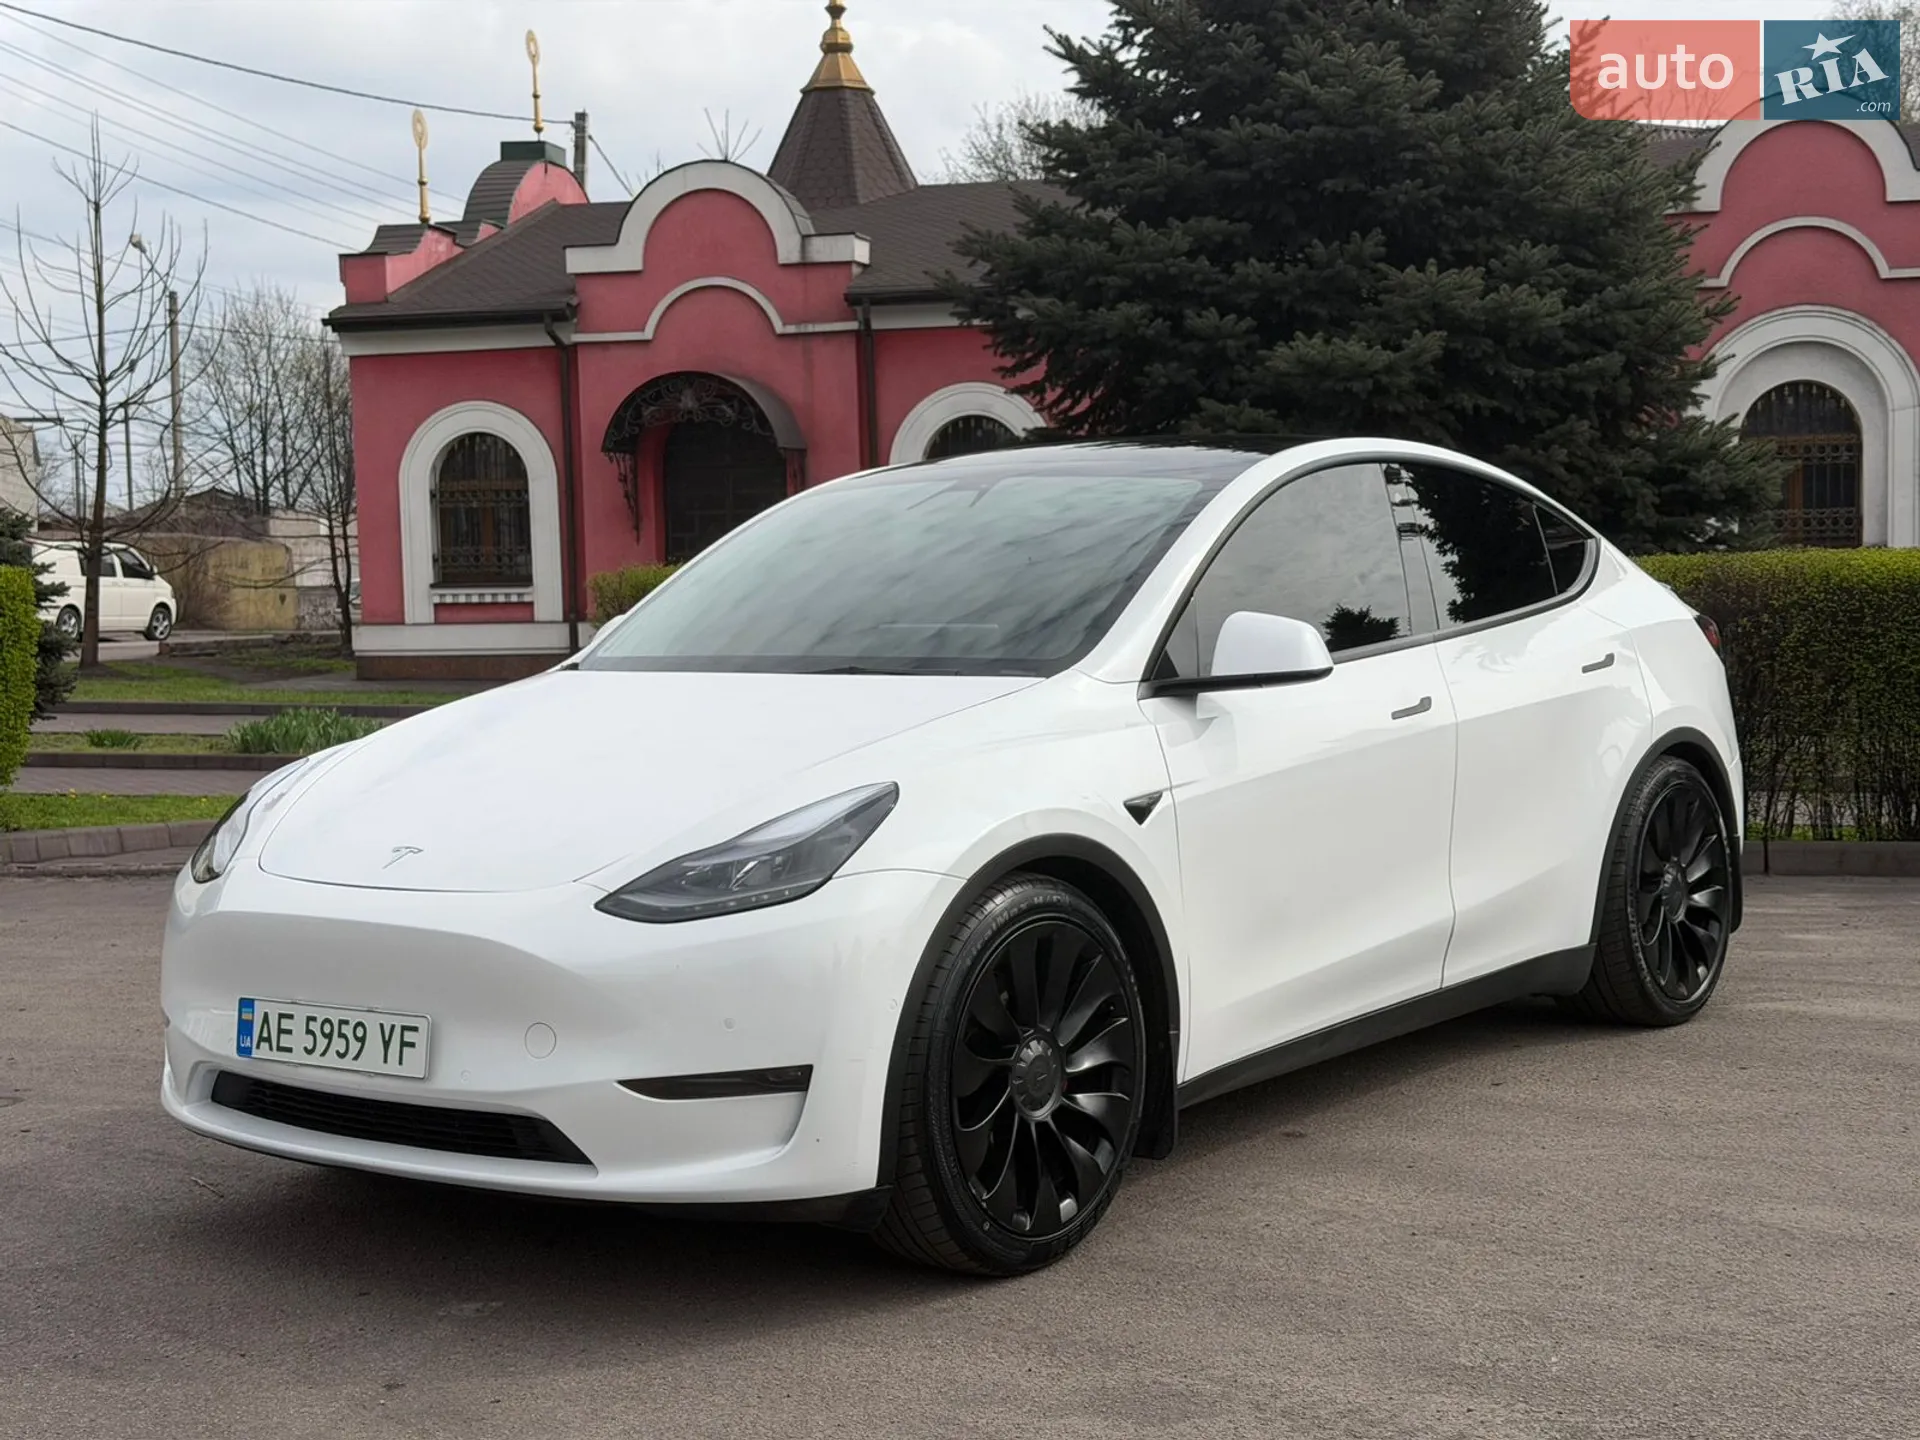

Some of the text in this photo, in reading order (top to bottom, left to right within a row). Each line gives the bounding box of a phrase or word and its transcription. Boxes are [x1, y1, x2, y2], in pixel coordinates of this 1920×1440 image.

[239, 1035, 251, 1048] UA
[255, 1011, 419, 1066] AE 5959 YF
